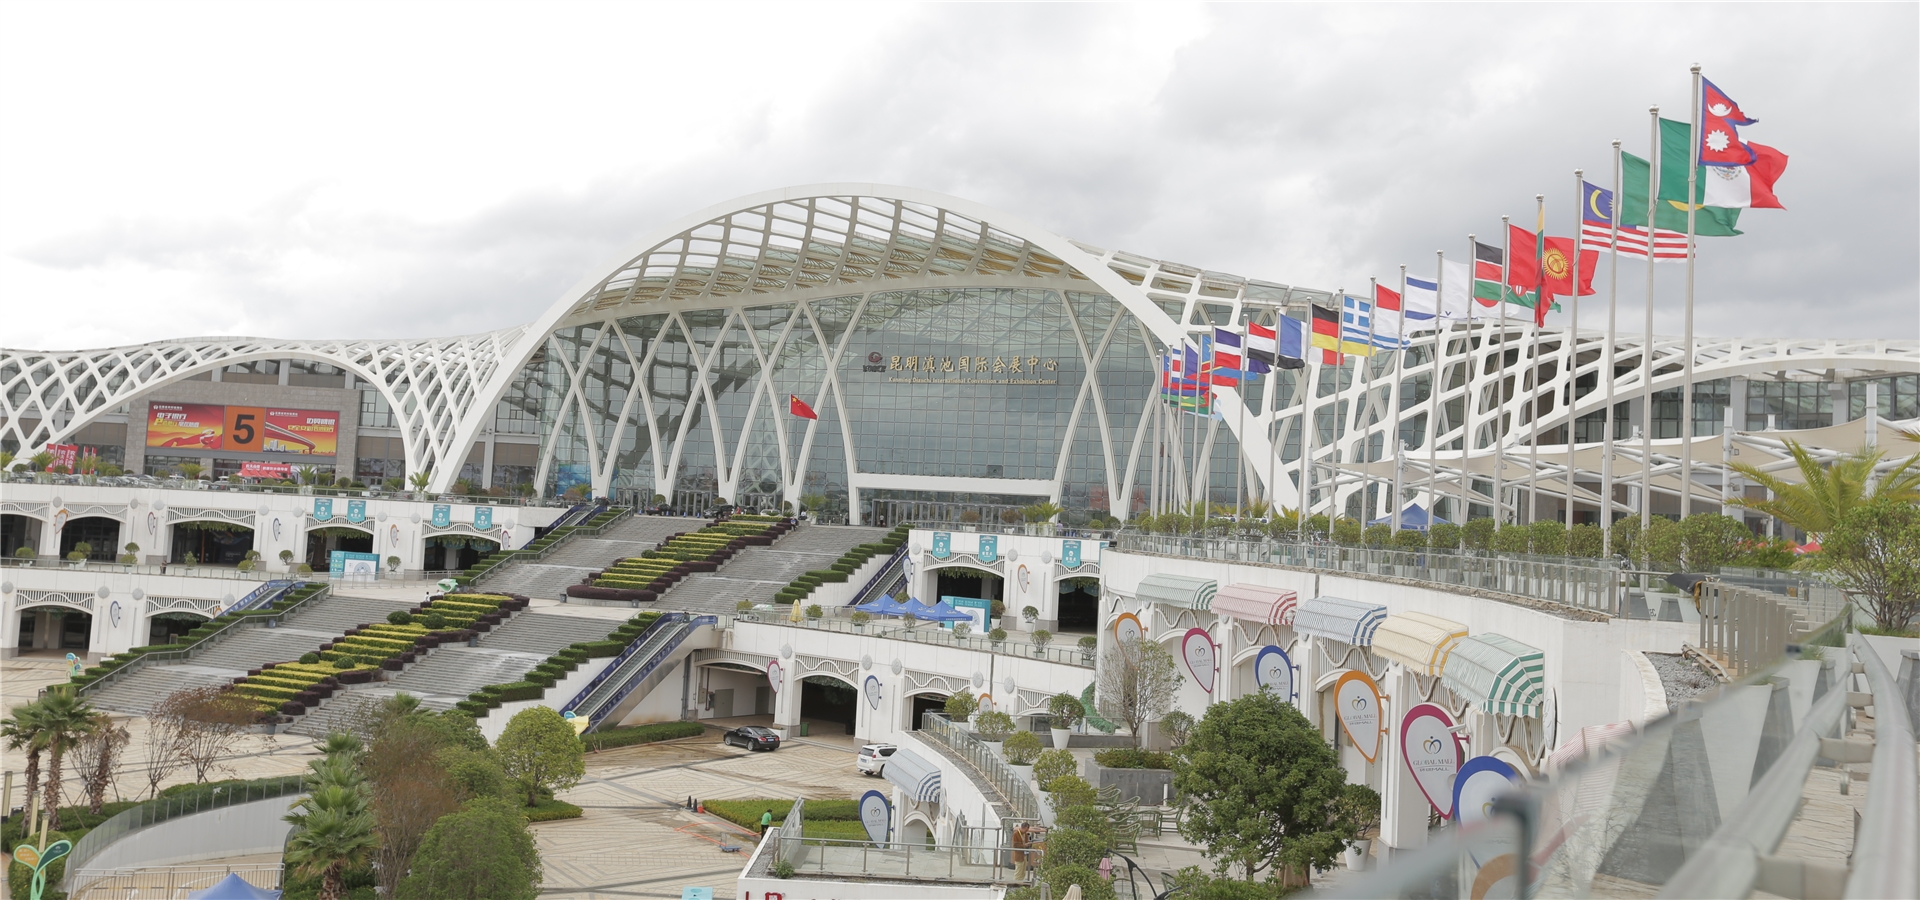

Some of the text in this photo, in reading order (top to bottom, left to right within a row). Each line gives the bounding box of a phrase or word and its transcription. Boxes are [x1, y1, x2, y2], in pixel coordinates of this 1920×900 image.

[889, 355, 1059, 374] 昆明滇池国际会展中心
[888, 377, 912, 385] Kunming
[232, 414, 255, 445] 5
